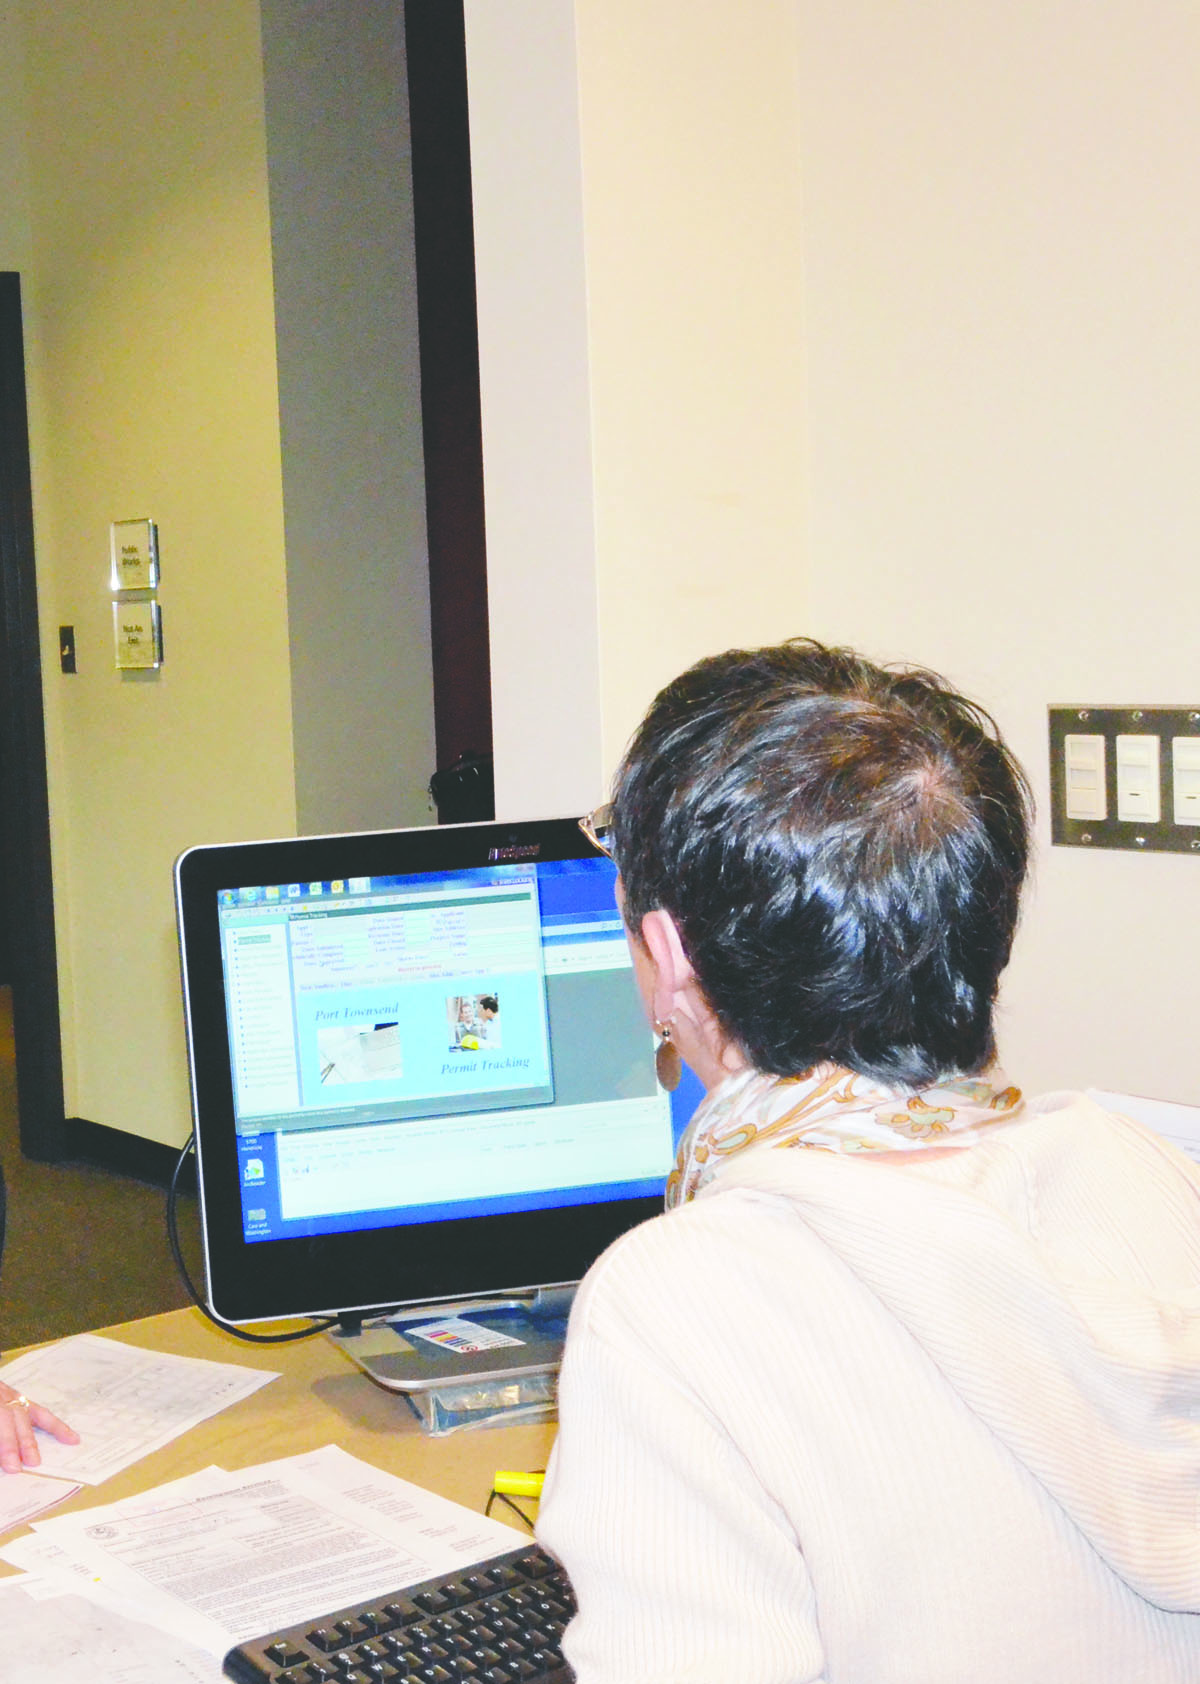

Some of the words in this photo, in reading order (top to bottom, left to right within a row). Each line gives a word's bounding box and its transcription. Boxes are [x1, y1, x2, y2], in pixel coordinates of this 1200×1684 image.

[315, 1007, 339, 1021] Port
[344, 1003, 399, 1018] Townsend
[440, 1060, 478, 1074] Permit
[482, 1056, 530, 1071] Tracking
